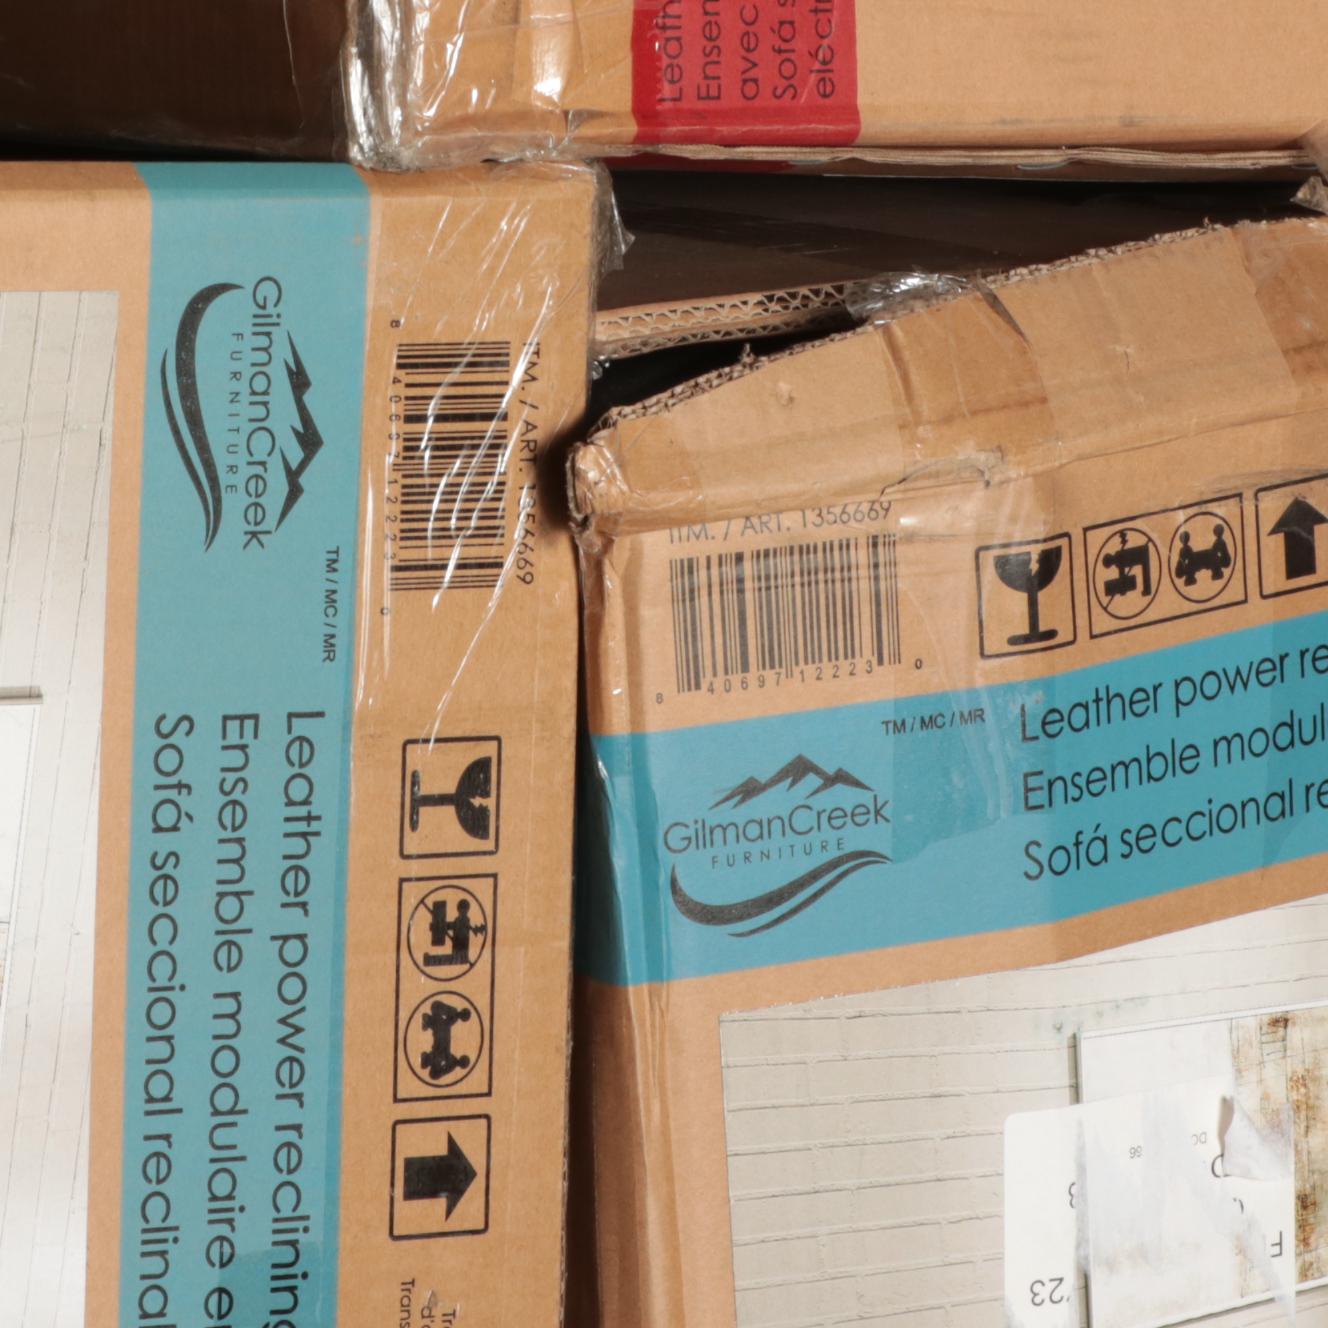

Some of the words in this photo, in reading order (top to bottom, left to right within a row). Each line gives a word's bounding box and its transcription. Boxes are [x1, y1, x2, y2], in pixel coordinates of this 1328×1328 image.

[737, 5, 760, 100] avec
[771, 20, 798, 100] Sofá
[224, 333, 244, 495] FURNITURE
[242, 276, 283, 550] GilmanCreek
[882, 720, 907, 736] TM
[920, 714, 947, 731] MC
[960, 708, 985, 725] MR
[1020, 681, 1163, 744] Leather
[1175, 653, 1289, 715] power
[151, 713, 194, 833] Sofá
[280, 711, 325, 916] Leather
[663, 795, 890, 853] GilmanCreek
[1023, 742, 1200, 813] Ensemble
[212, 713, 260, 972] Ensemble
[711, 839, 844, 870] FURNITURE
[1024, 825, 1108, 880] Sofá
[1120, 778, 1293, 860] seccional
[143, 851, 186, 1115] seccional
[270, 934, 309, 1108] power
[204, 992, 247, 1269] modulaire
